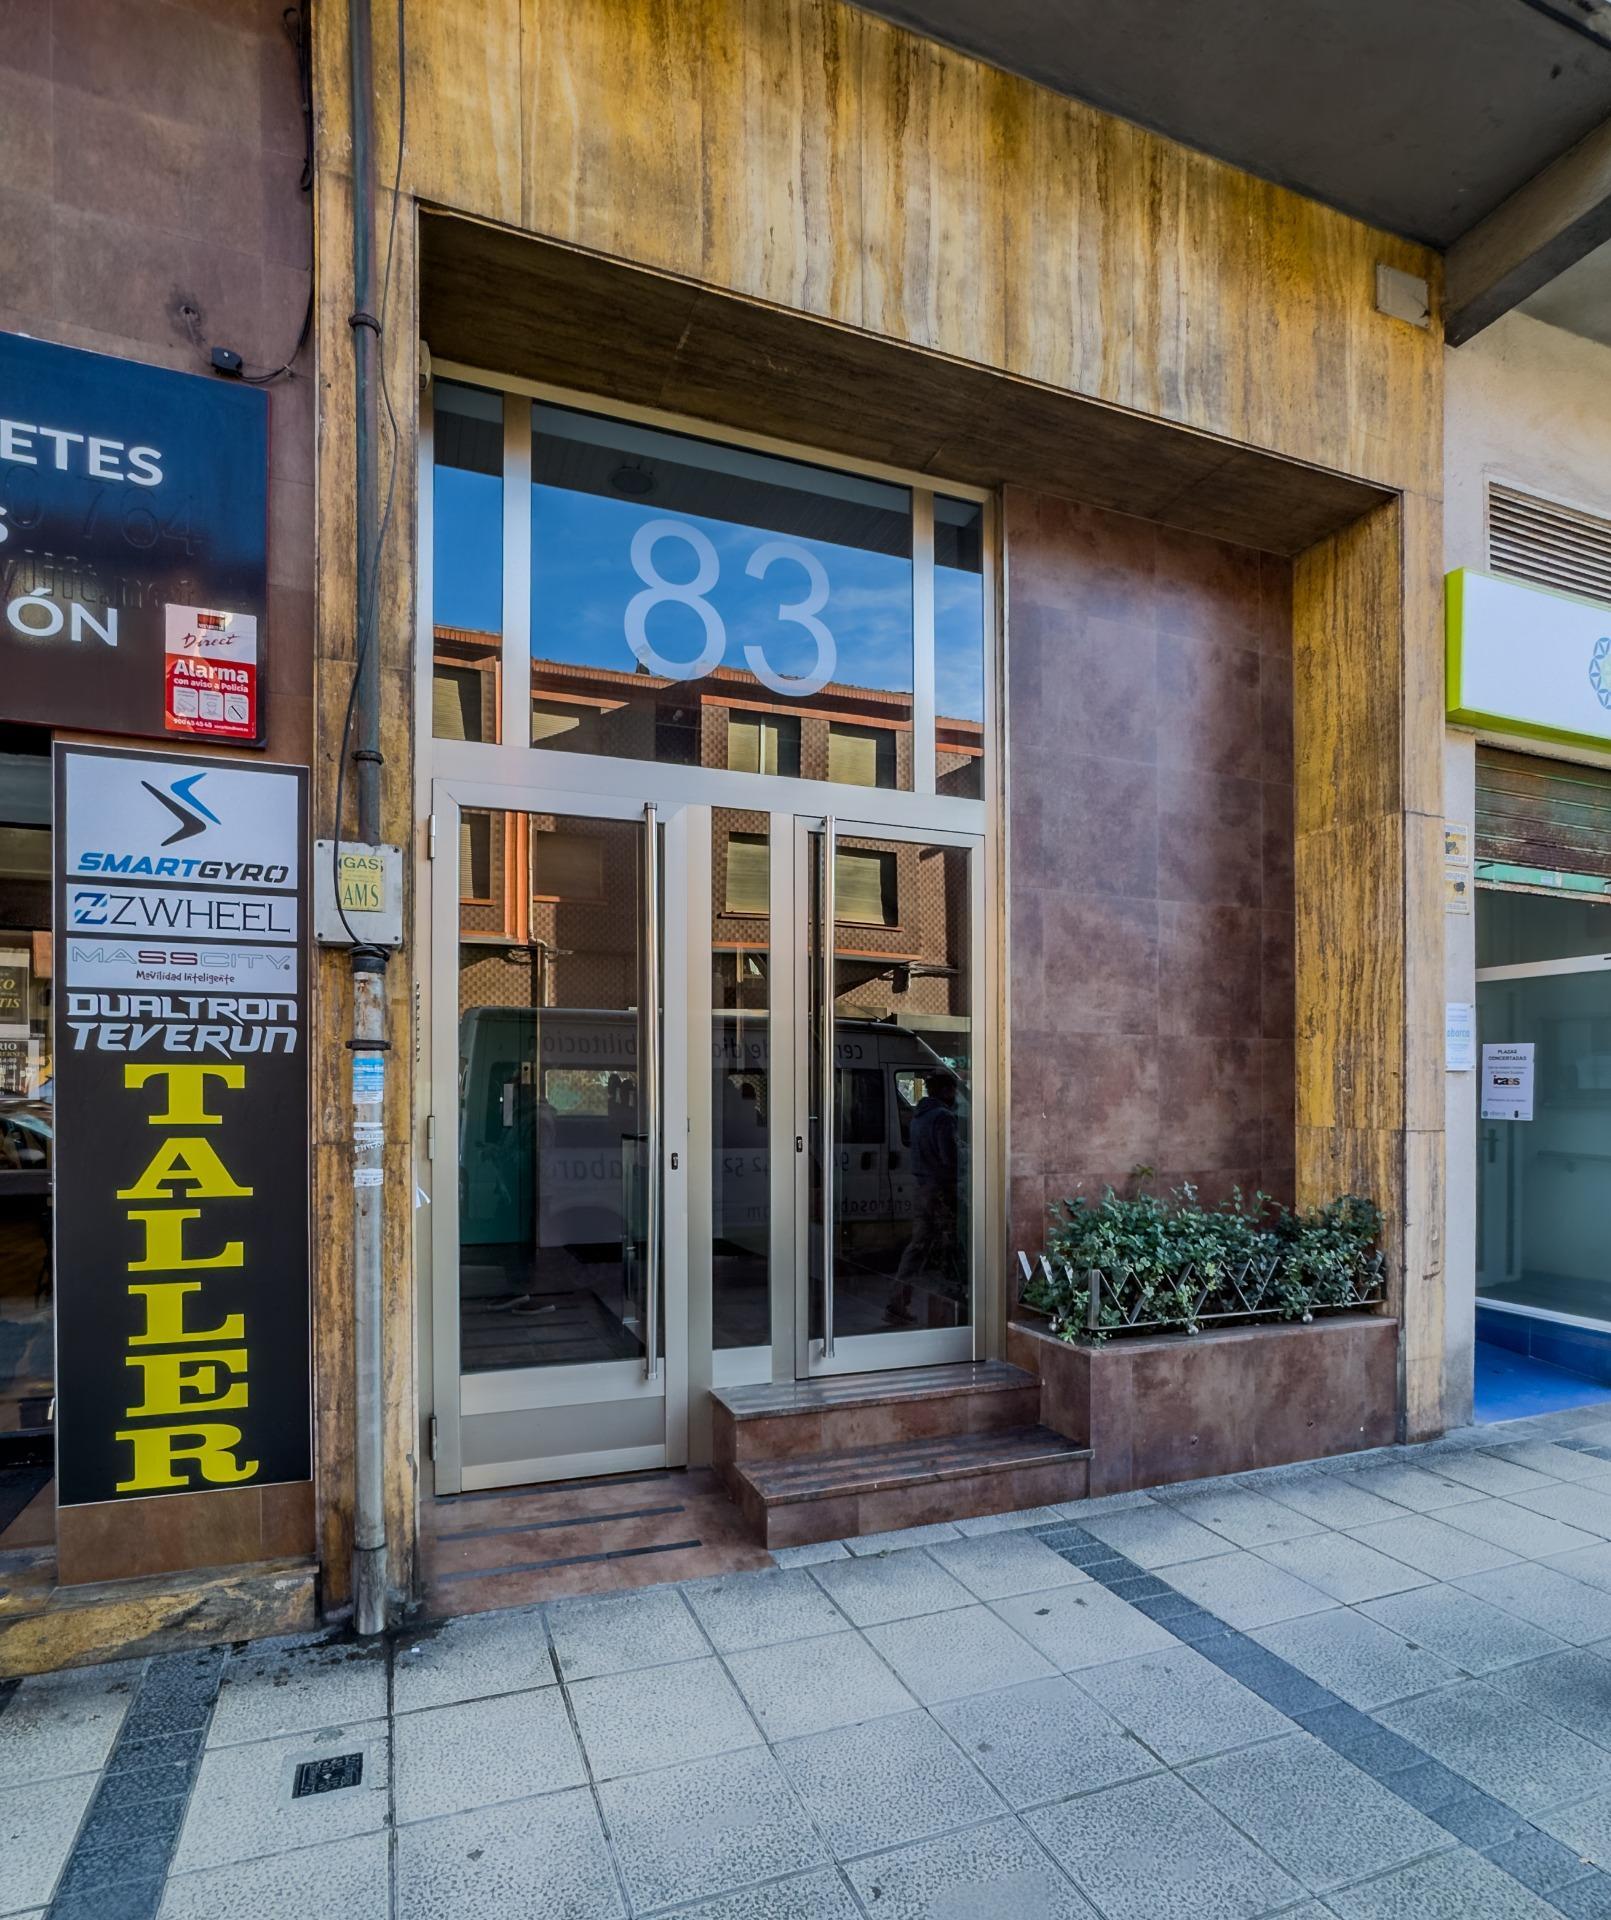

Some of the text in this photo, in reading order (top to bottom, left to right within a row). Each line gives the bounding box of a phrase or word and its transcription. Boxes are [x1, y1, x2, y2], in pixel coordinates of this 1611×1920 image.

[0, 419, 163, 486] ETES
[7, 587, 118, 647] ÓN
[624, 519, 837, 697] 83
[183, 632, 239, 649] Direct
[173, 678, 189, 686] con
[191, 680, 213, 688] aviso
[174, 659, 249, 683] Alarma
[78, 852, 289, 884] SMARTGYRO
[343, 857, 379, 870] GAS
[343, 883, 379, 907] AMS
[184, 972, 235, 985] Inteligente
[67, 992, 298, 1026] DUALTRON
[67, 1022, 298, 1060] TEVERUN
[116, 1063, 259, 1492] TALLER
